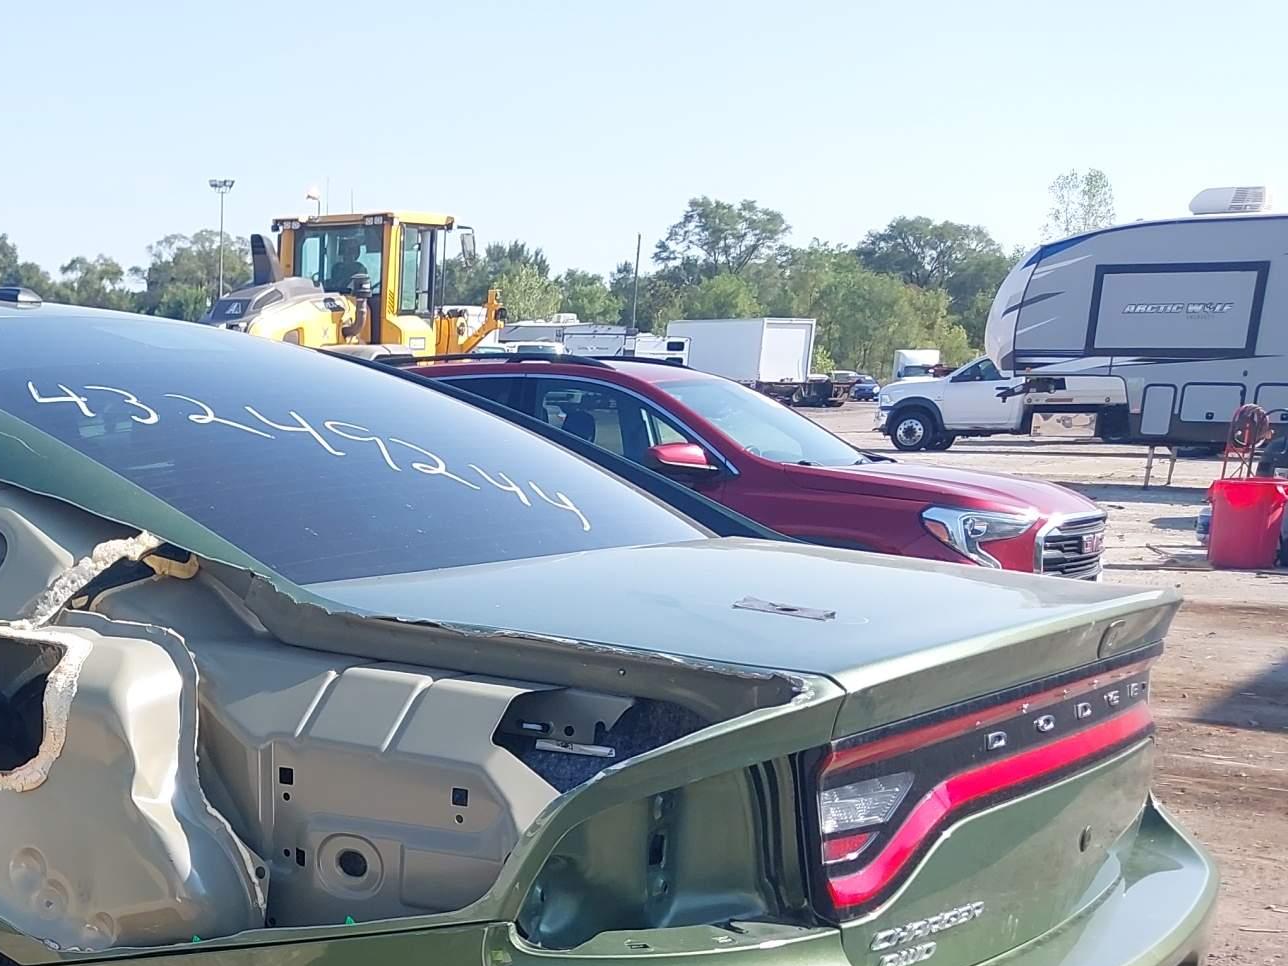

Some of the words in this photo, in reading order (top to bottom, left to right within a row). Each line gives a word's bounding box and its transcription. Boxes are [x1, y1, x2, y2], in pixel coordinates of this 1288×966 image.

[1121, 303, 1185, 314] ARCTIC
[1186, 302, 1234, 313] WOLF
[27, 380, 591, 531] 43249244
[870, 901, 985, 951] CHARGER
